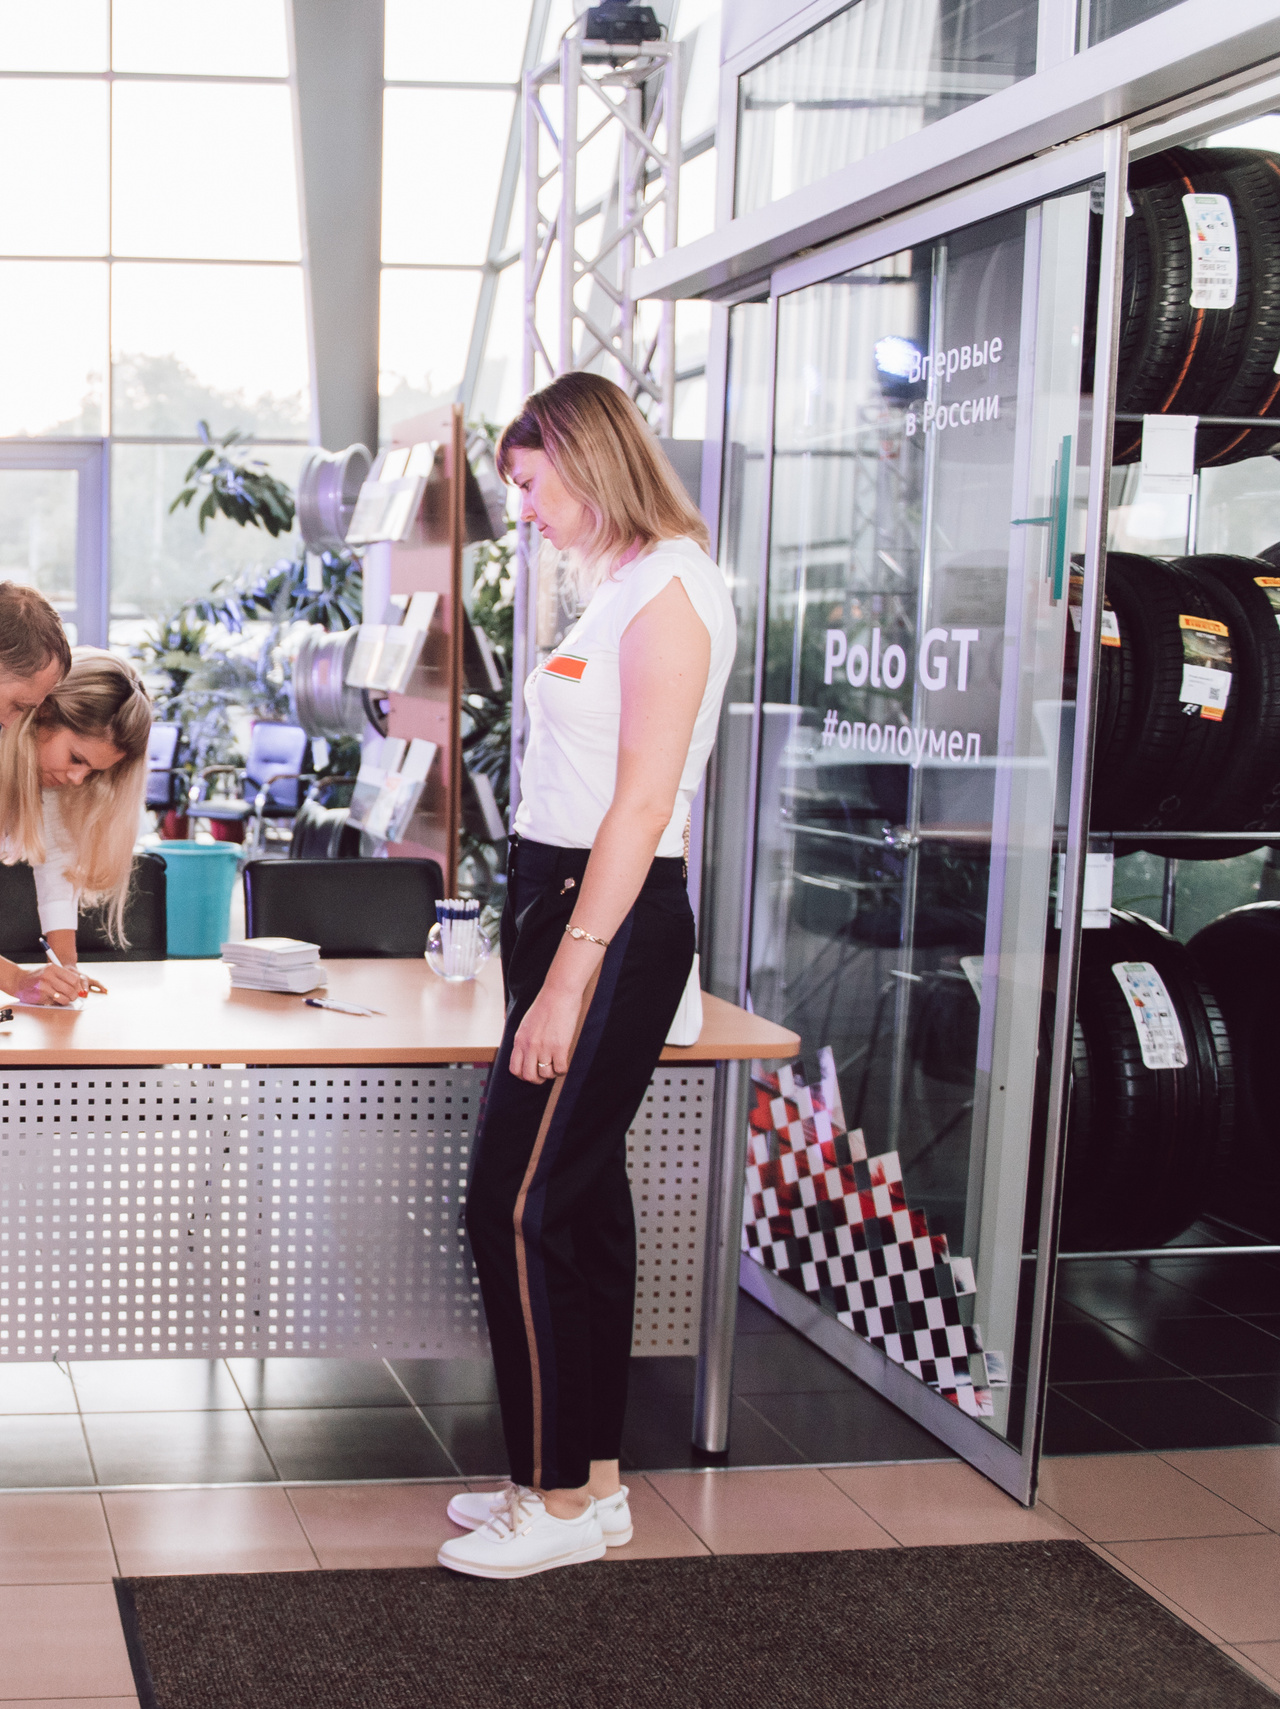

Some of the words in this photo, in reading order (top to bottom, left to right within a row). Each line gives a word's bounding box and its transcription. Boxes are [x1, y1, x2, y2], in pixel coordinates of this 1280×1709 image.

[908, 337, 1002, 383] Впервые
[906, 413, 916, 436] в
[923, 396, 999, 432] России
[824, 627, 906, 689] Polo
[919, 627, 979, 691] GT
[822, 709, 981, 769] #ополоумел
